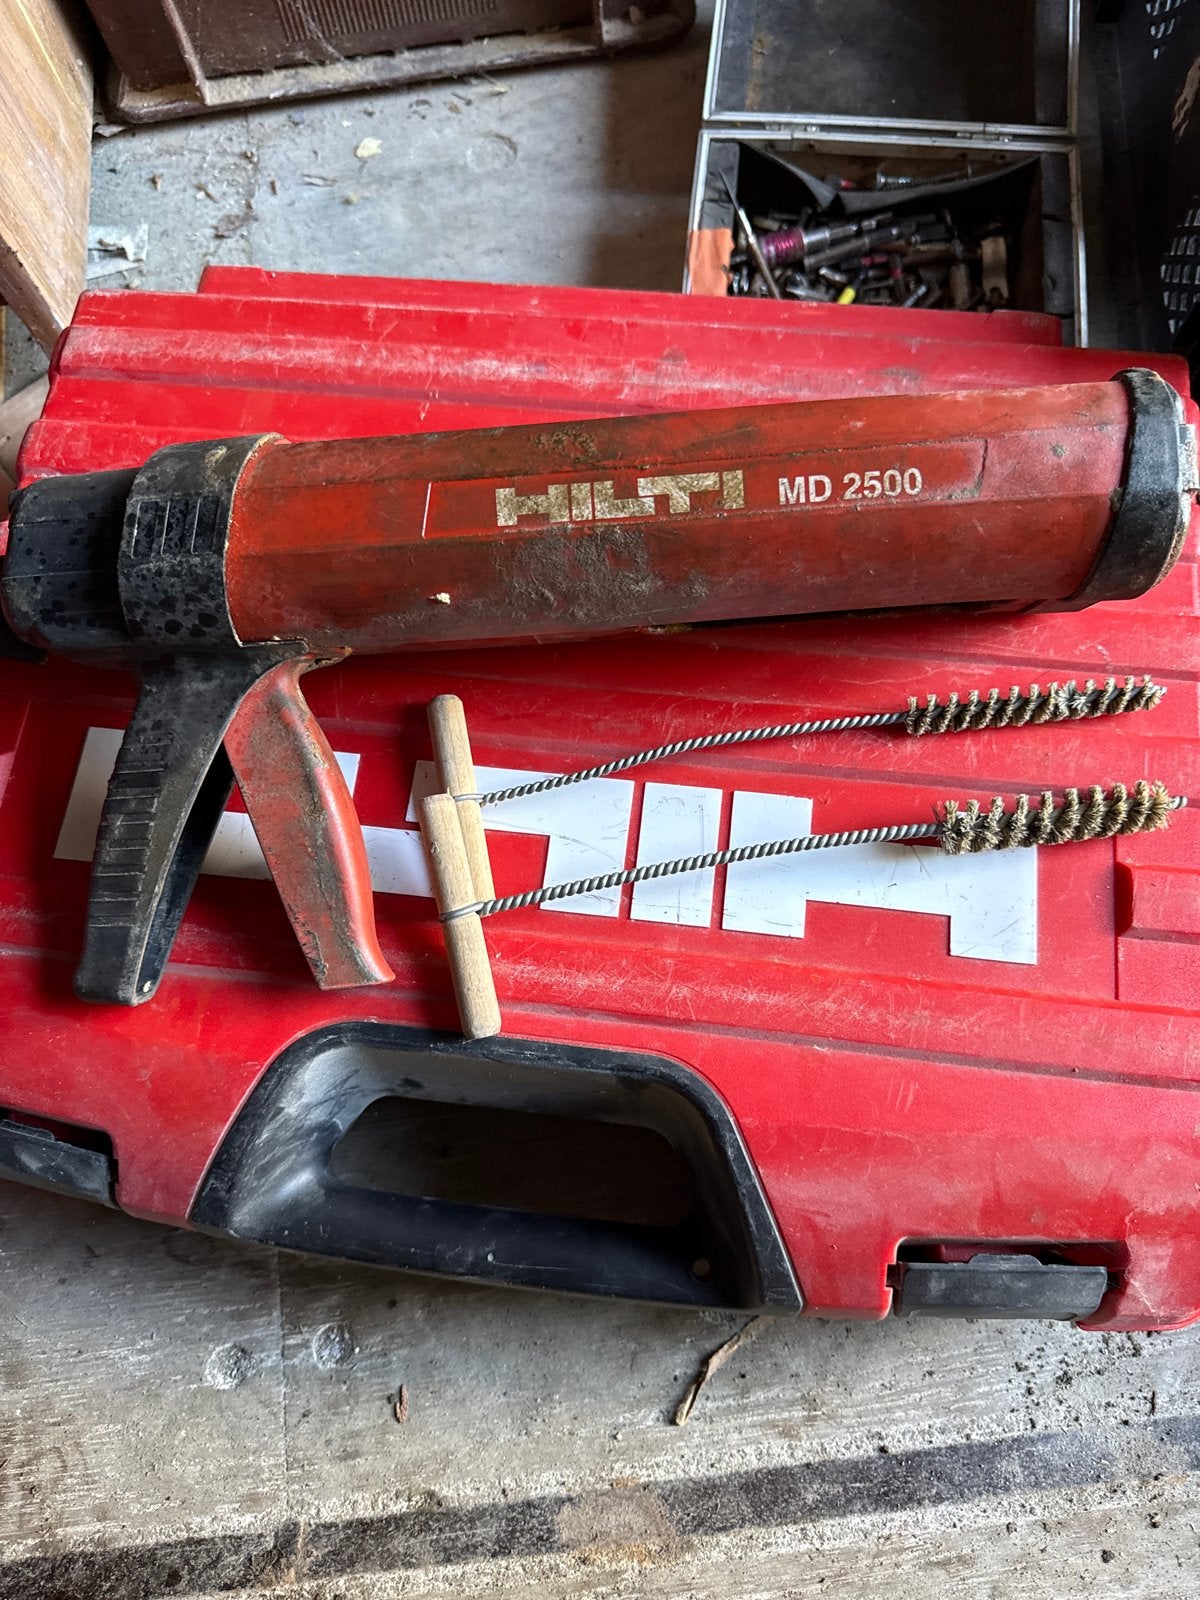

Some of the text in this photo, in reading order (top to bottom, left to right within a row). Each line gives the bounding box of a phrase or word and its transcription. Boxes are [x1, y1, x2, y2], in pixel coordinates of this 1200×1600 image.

[495, 467, 923, 526] HILTI MD 2500
